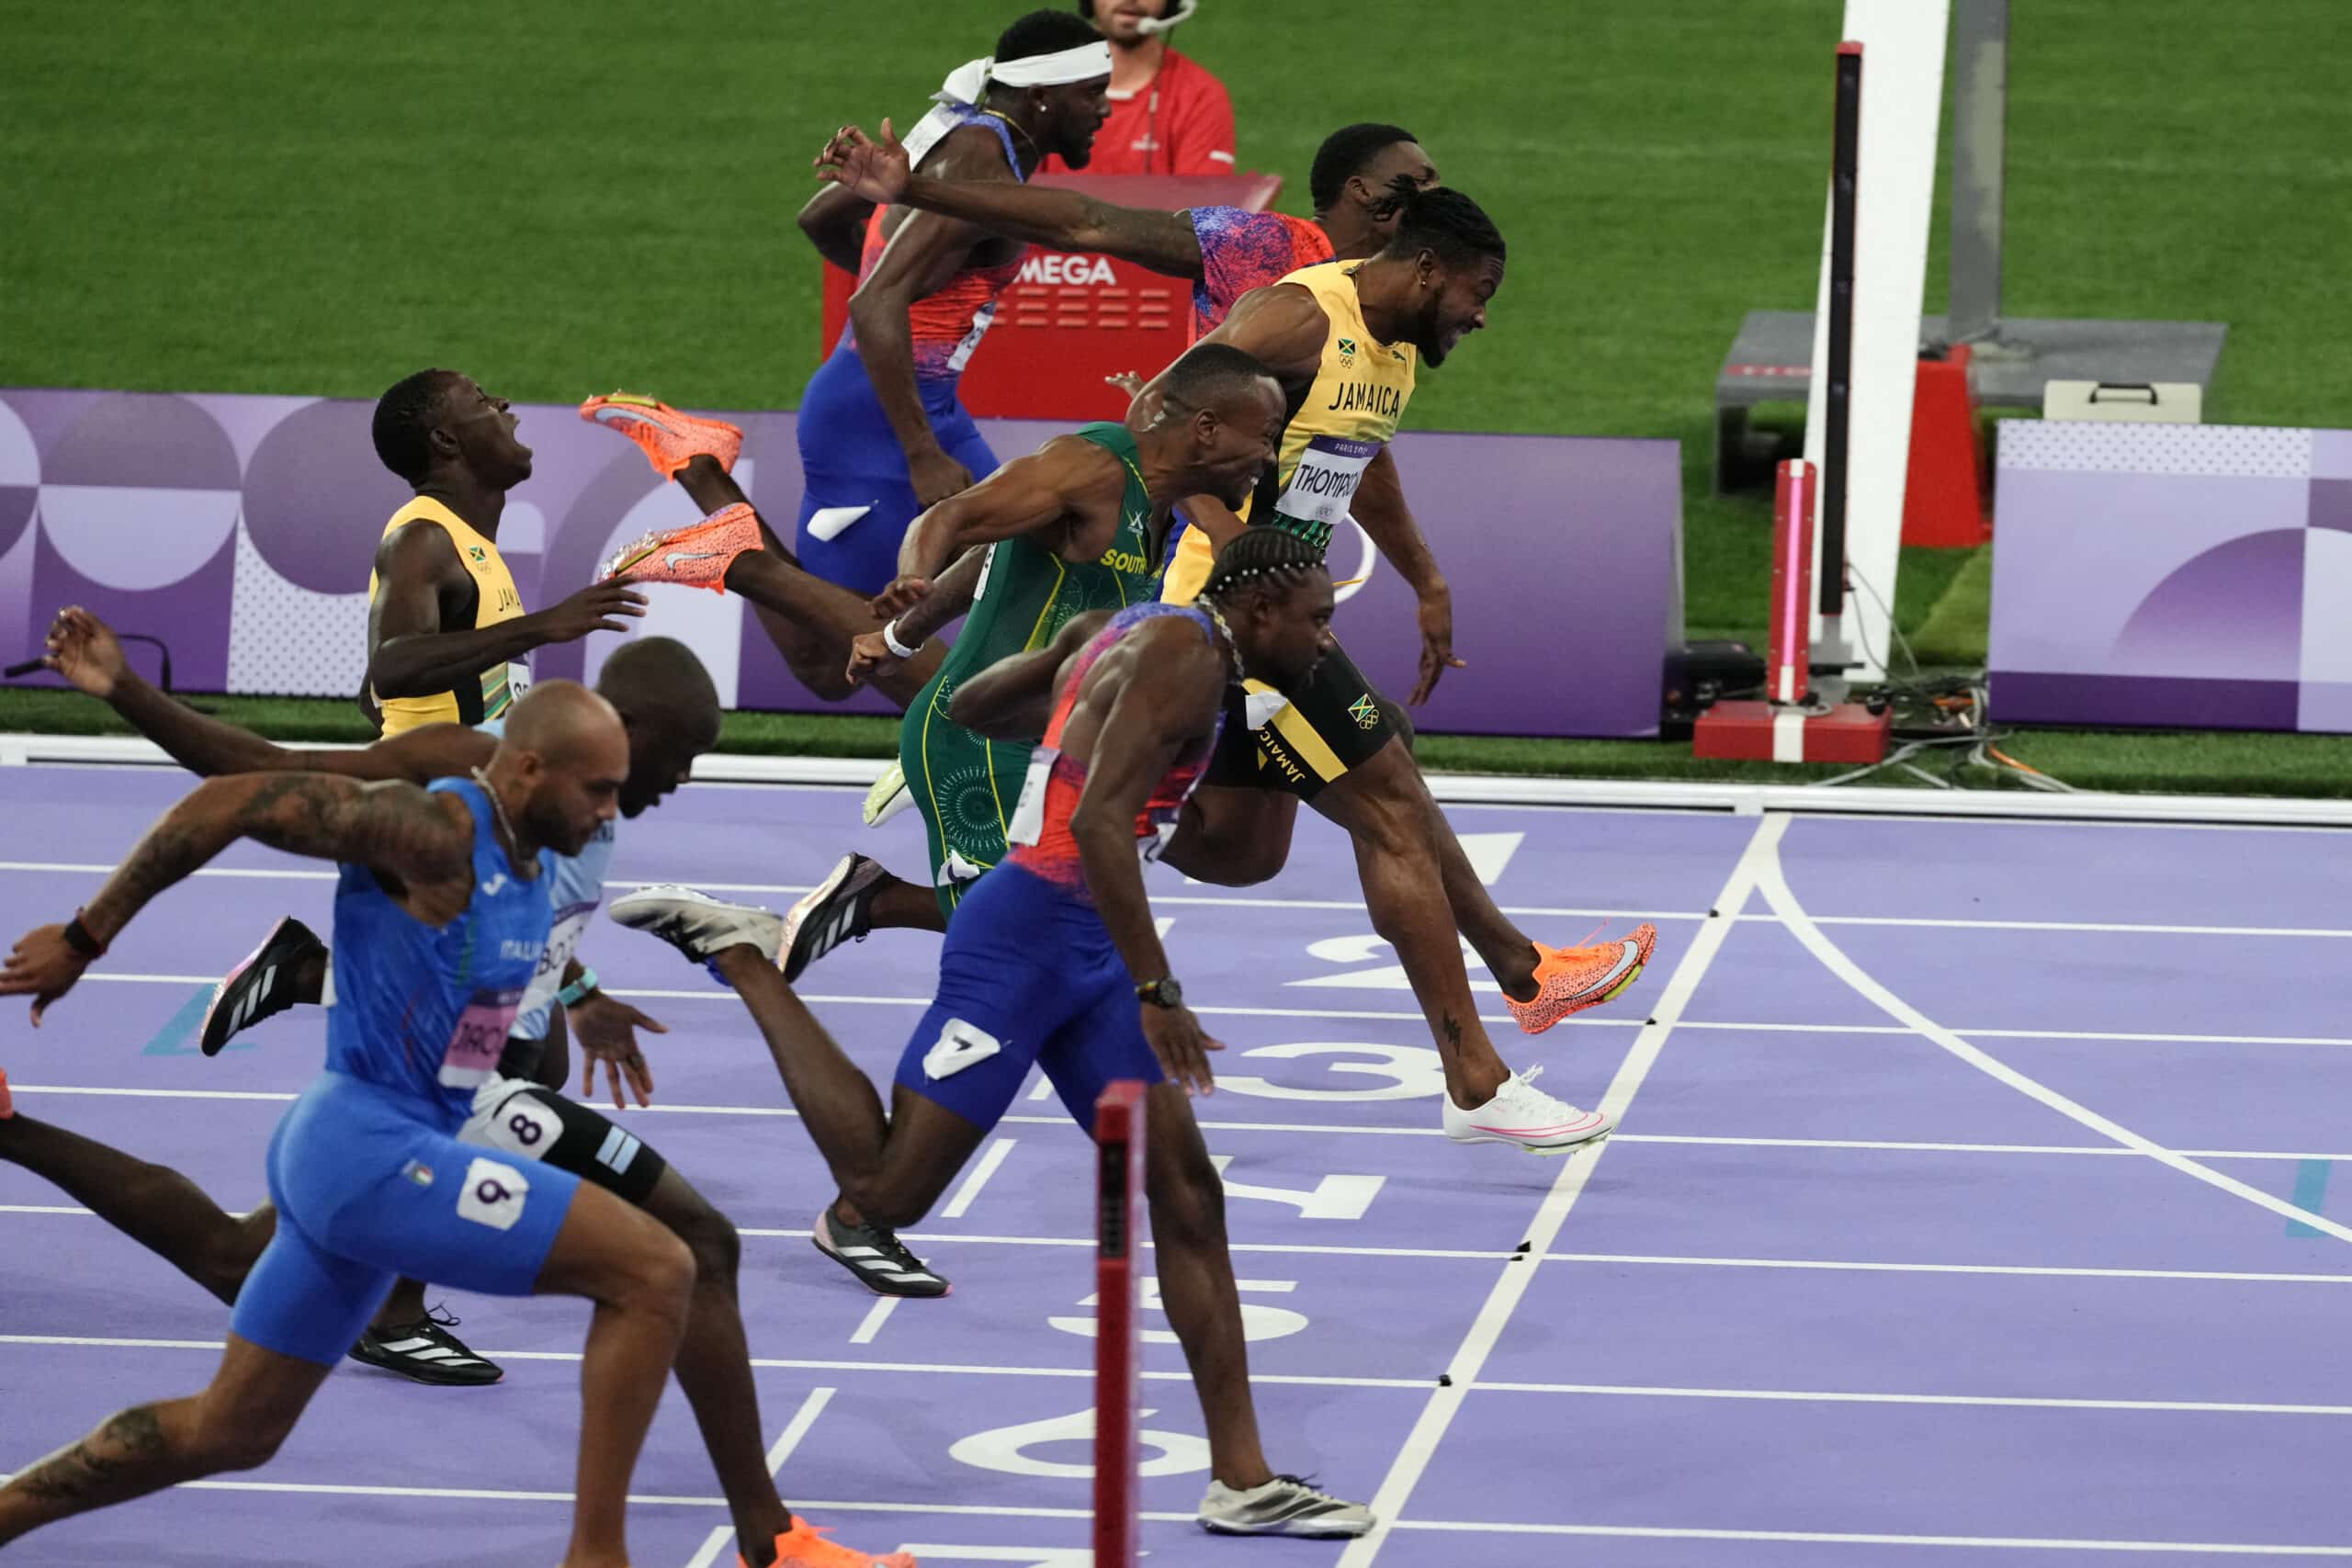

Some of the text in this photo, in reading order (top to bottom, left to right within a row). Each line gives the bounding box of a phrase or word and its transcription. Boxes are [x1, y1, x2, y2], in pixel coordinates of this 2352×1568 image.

[1329, 382, 1401, 418] JAMAICA
[1213, 1042, 1446, 1102] 3
[509, 1113, 543, 1146] 8
